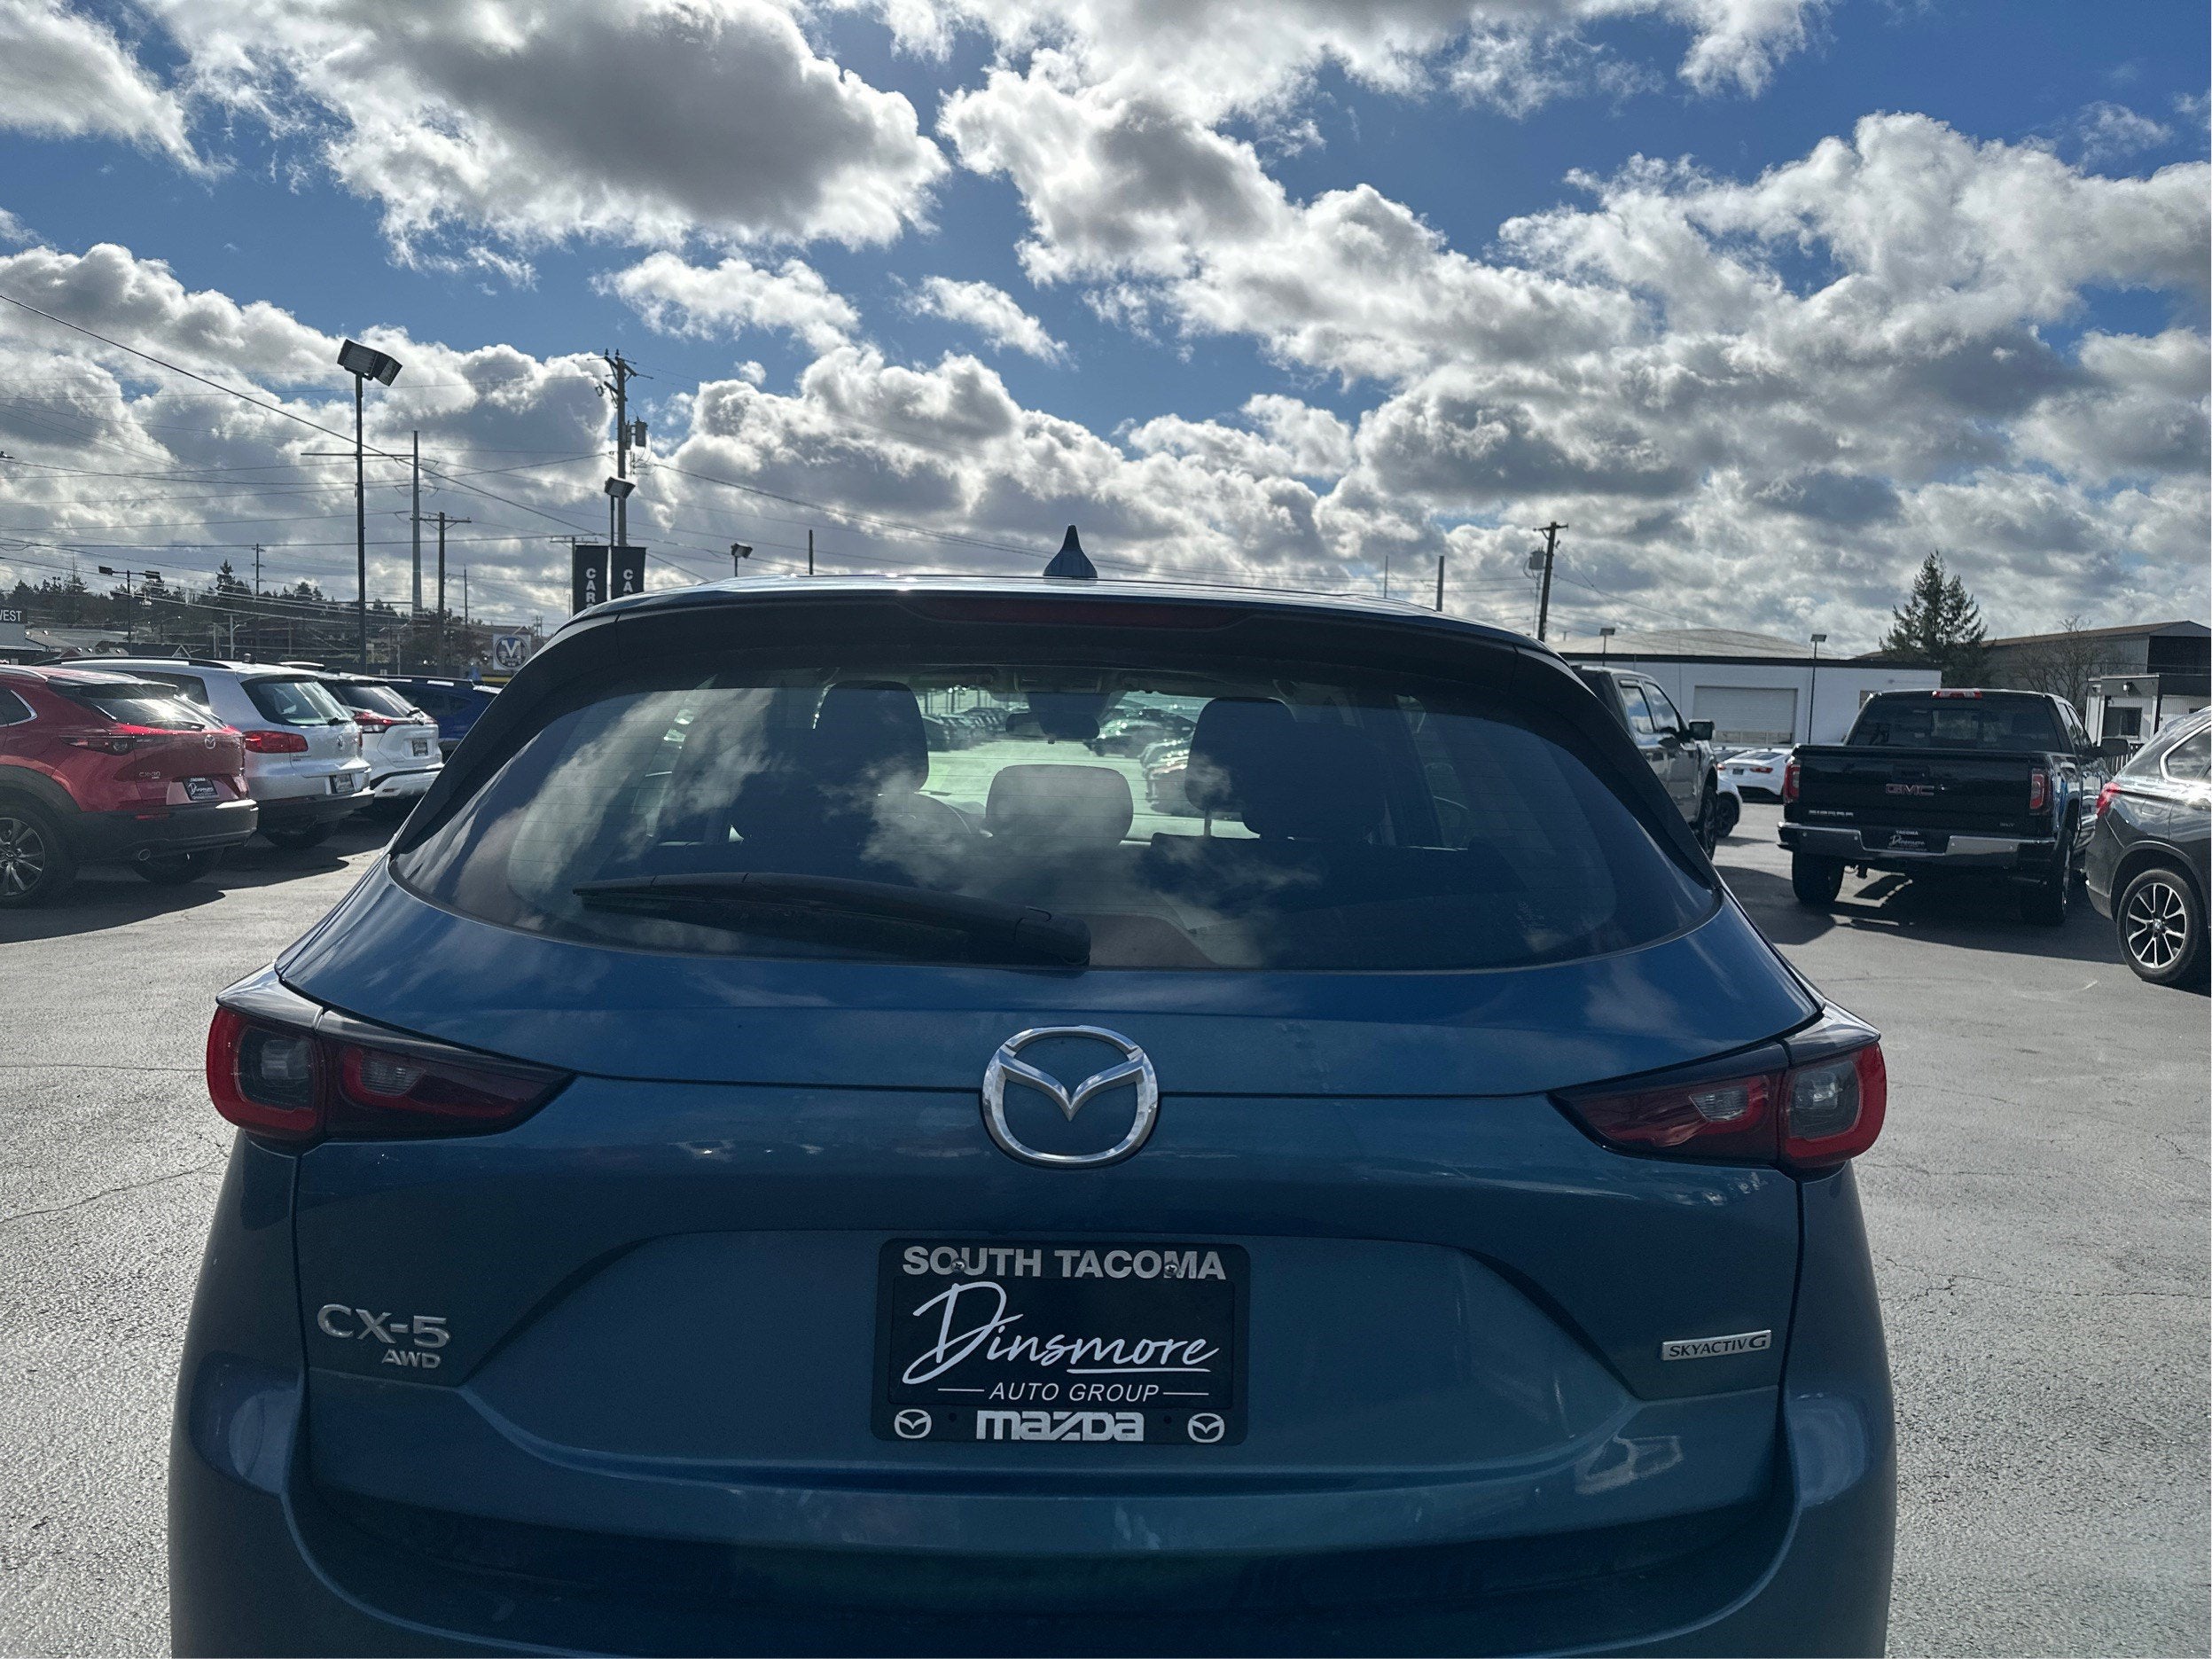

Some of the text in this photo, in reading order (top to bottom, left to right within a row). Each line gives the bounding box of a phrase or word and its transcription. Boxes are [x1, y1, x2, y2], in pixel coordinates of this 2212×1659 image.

[622, 568, 634, 596] CA
[1885, 783, 1935, 796] GMC
[903, 1246, 1227, 1280] SOUTH TACOMA
[317, 1303, 451, 1349] CX-5
[902, 1281, 1220, 1385] Dinsmore
[381, 1349, 442, 1369] AWD
[989, 1382, 1160, 1403] AUTO GROUP
